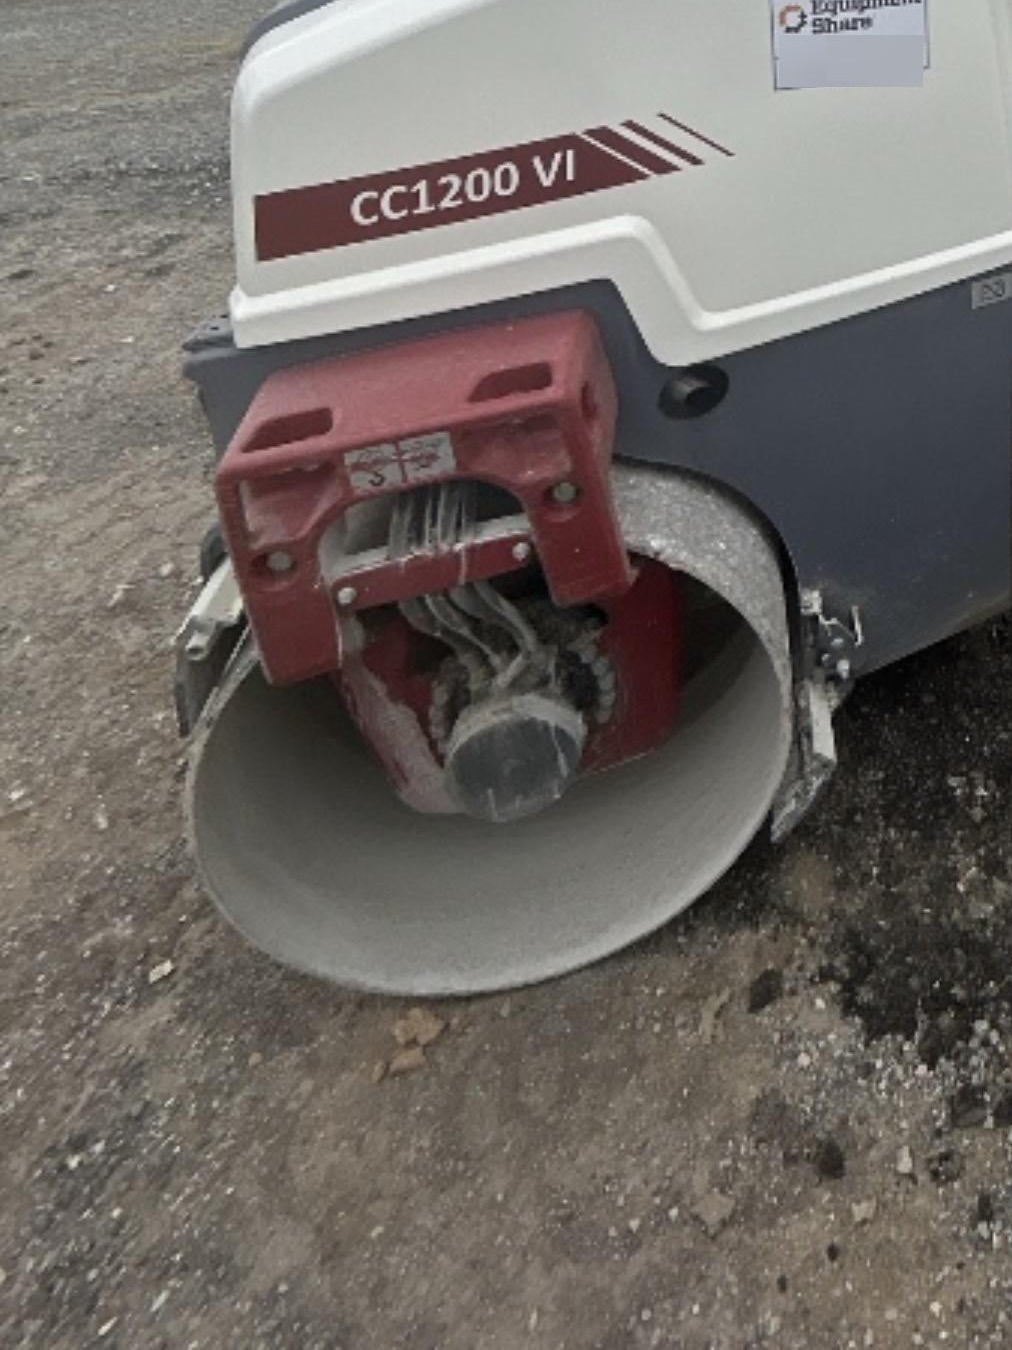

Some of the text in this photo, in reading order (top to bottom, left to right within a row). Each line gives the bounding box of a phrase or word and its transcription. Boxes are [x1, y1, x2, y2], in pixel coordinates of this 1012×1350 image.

[811, 15, 874, 34] Share
[350, 149, 575, 226] CC1200 VI
